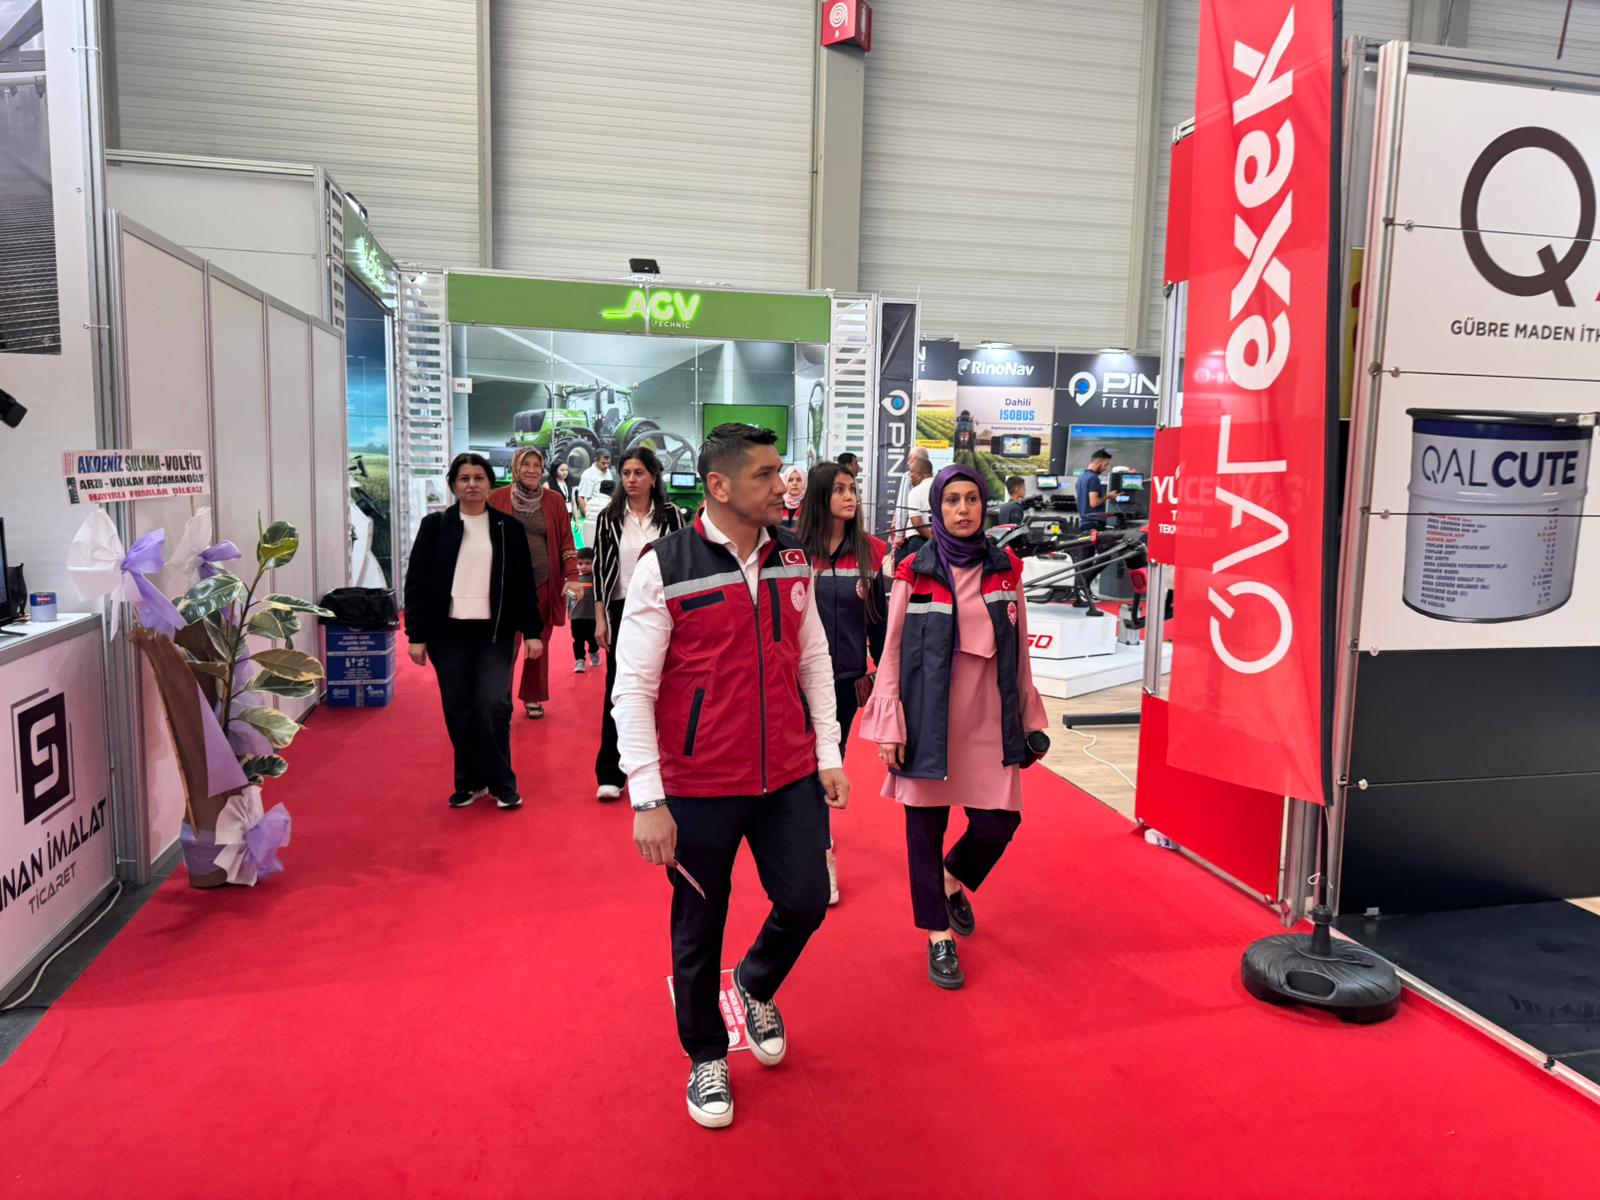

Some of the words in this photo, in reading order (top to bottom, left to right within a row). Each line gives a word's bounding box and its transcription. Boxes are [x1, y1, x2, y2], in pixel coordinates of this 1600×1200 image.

[1460, 125, 1600, 308] Q
[602, 289, 700, 322] AGV
[1450, 317, 1510, 338] GÜBRE
[1514, 323, 1576, 342] MADEN
[999, 409, 1036, 421] ISOBUS
[1005, 398, 1032, 407] Dahili
[77, 452, 124, 474] AKDENİZ
[1421, 445, 1579, 488] QALCUTE
[110, 476, 145, 488] VOLKAN
[46, 797, 107, 870] İMALAT
[28, 861, 77, 915] TİCARET
